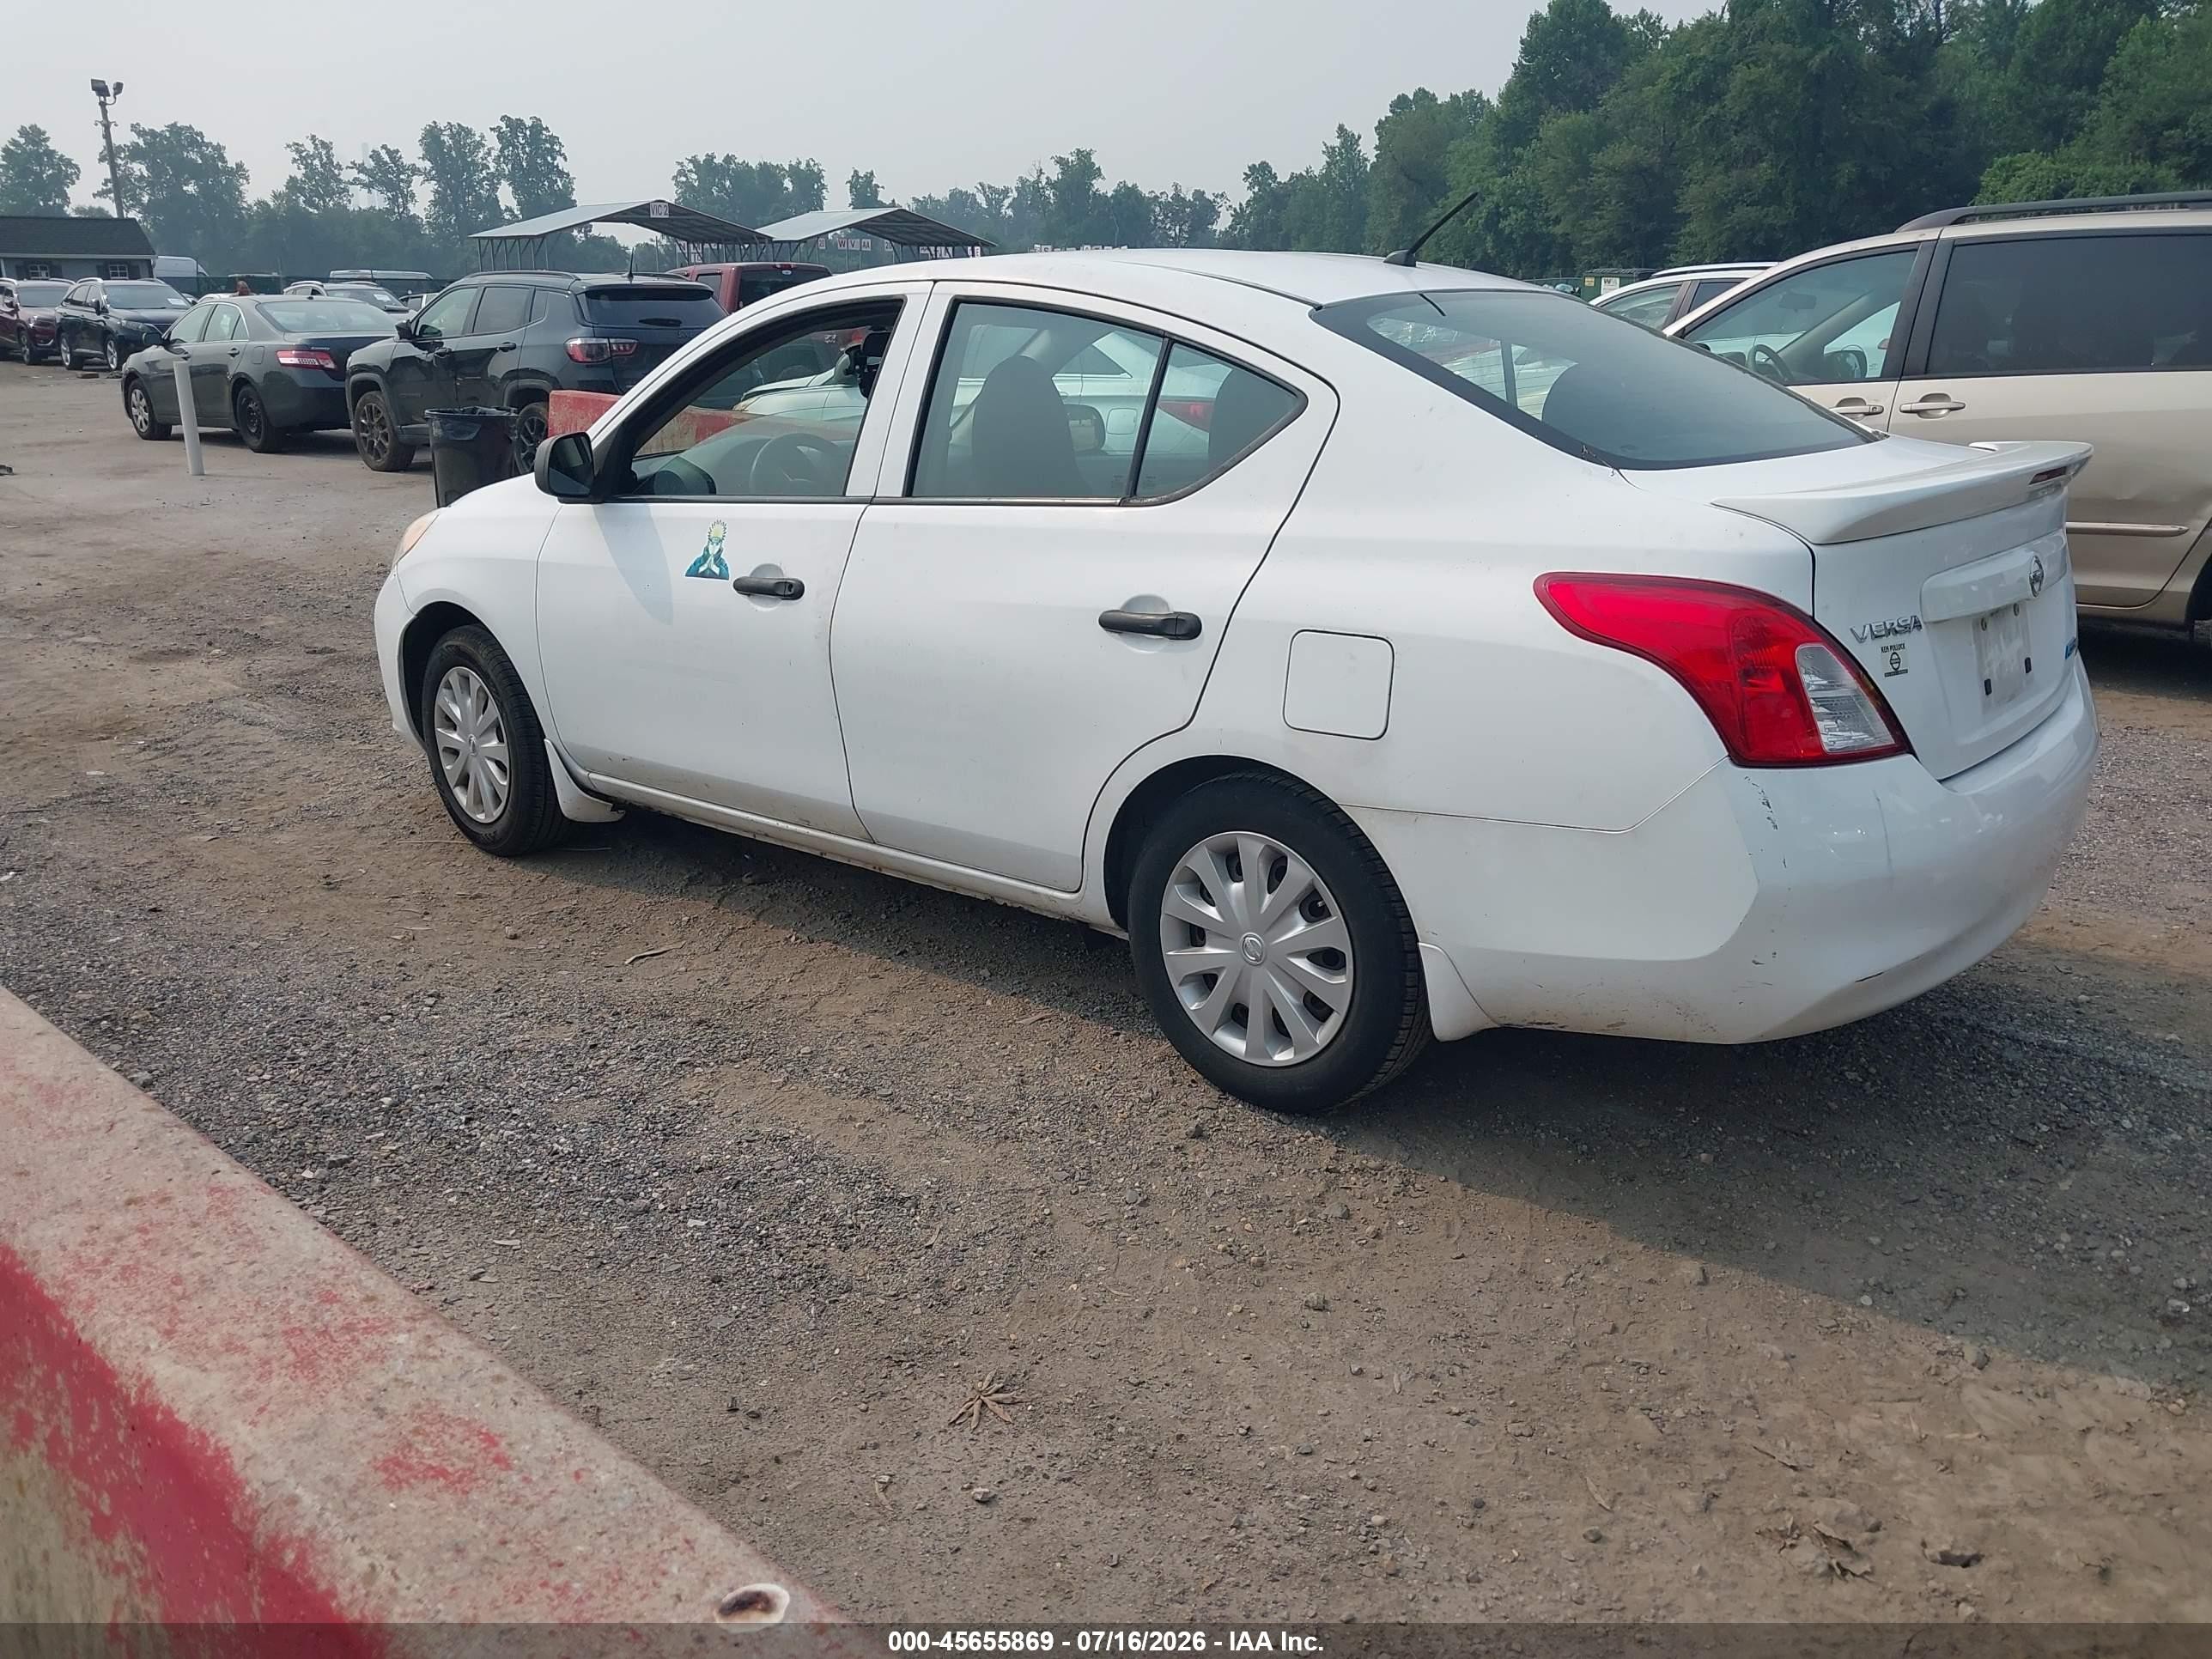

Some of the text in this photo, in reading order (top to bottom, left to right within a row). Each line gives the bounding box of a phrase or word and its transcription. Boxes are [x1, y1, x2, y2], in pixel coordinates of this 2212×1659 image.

[650, 204, 669, 216] VIC 2
[838, 240, 847, 248] W
[1850, 615, 1923, 643] VERSA
